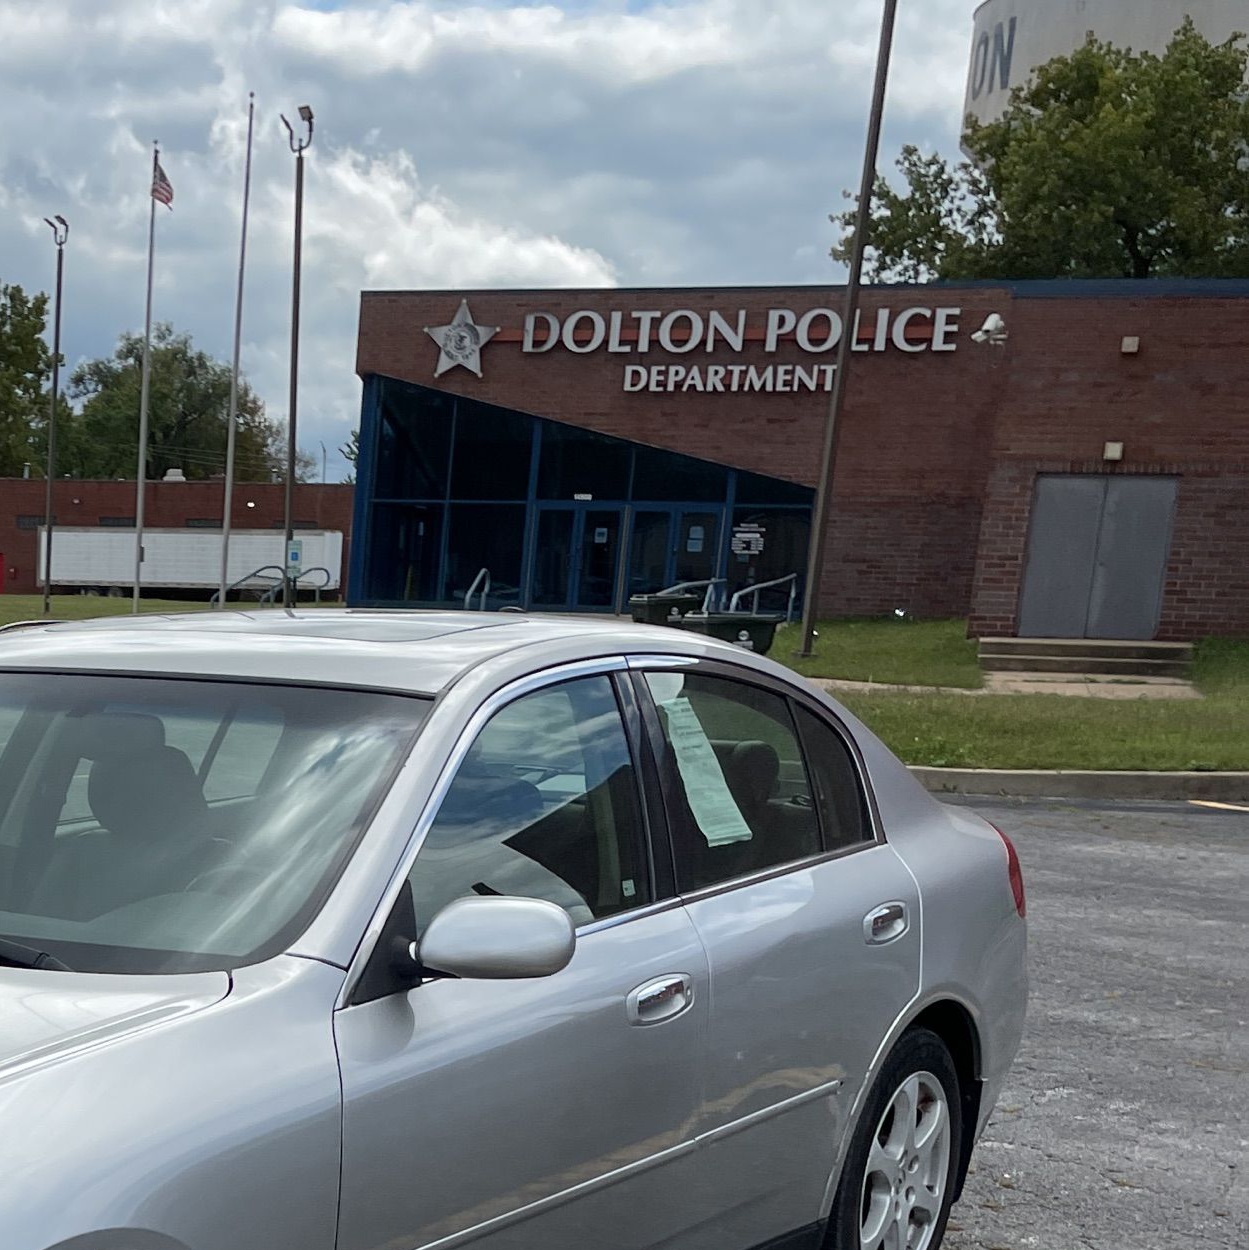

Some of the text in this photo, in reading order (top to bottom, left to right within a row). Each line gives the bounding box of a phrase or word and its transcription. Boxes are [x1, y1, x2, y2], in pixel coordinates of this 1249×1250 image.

[522, 309, 747, 354] DOLTON
[764, 307, 962, 353] POLICE
[622, 364, 838, 393] DEPARTMENT
